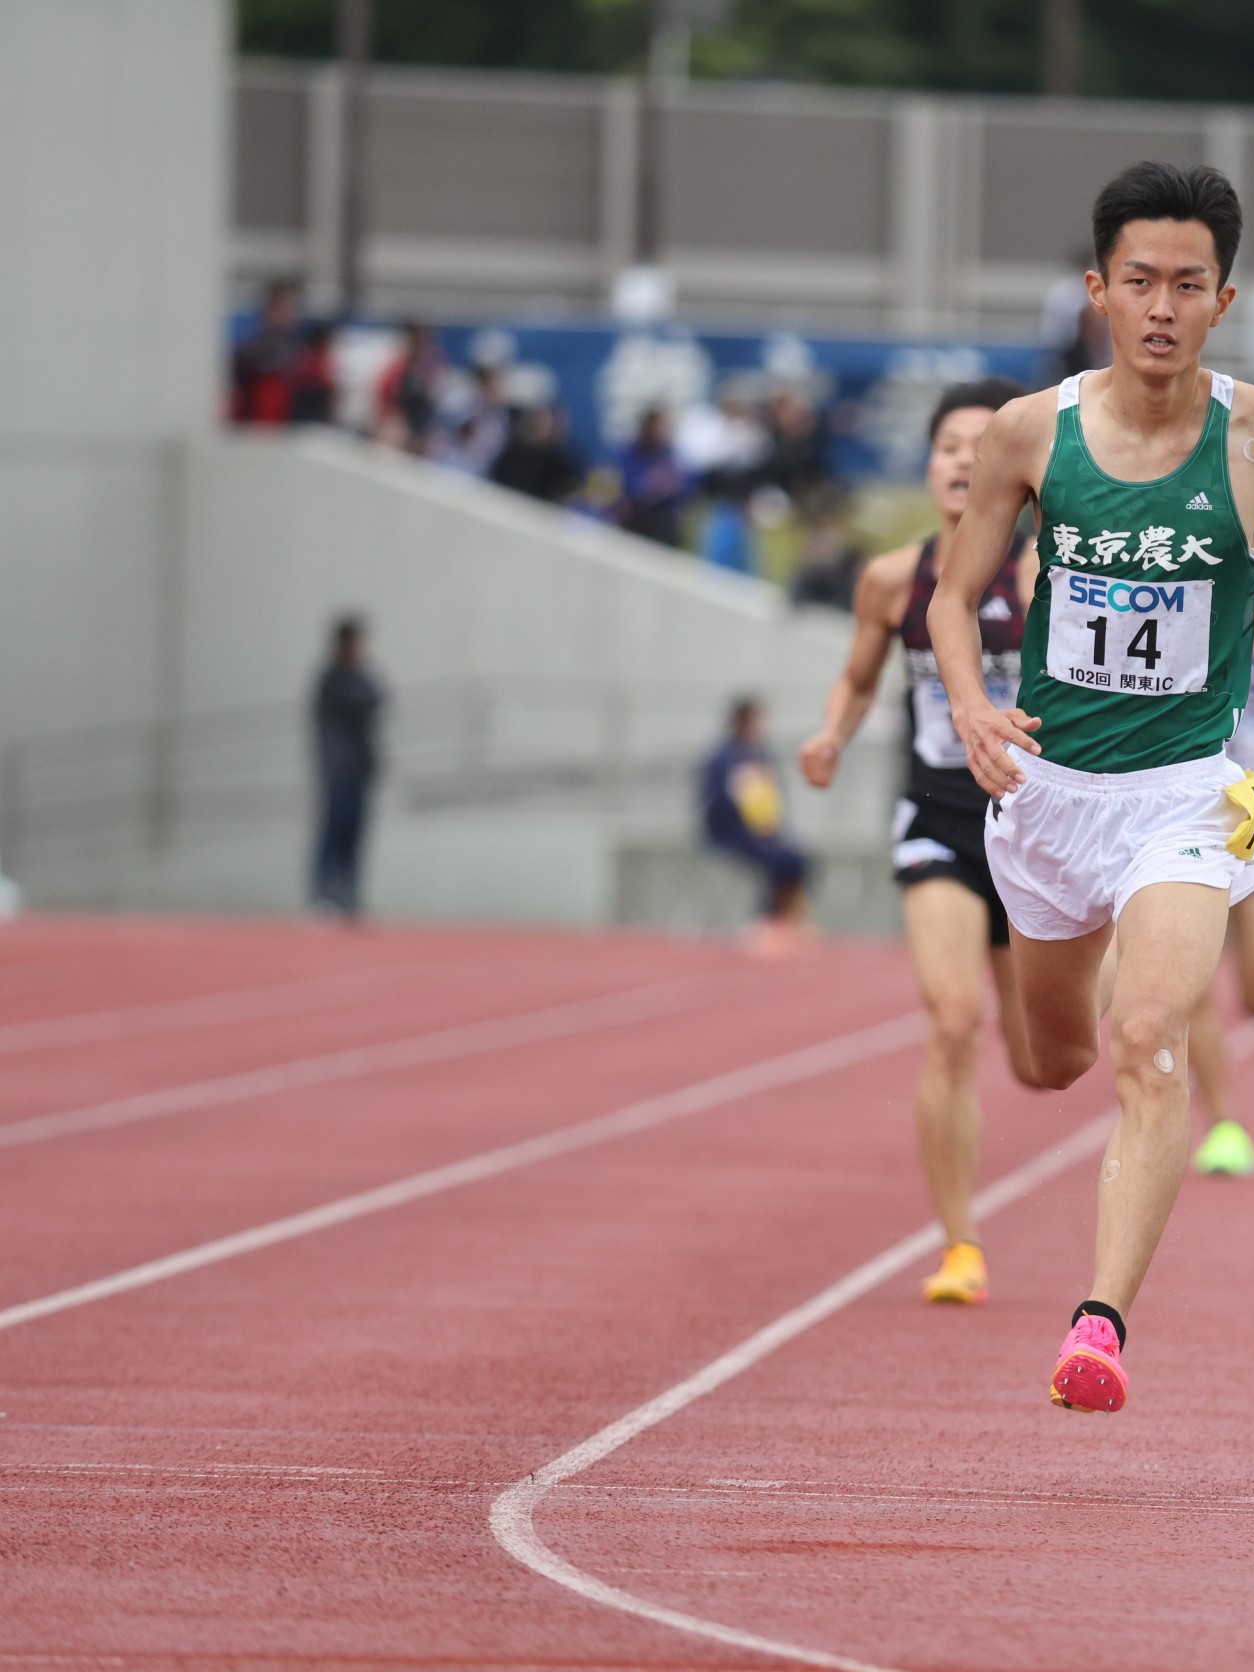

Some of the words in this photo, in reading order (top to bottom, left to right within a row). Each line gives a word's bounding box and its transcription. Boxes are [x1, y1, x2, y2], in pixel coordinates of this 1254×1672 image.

[1185, 502, 1213, 511] adidas
[1053, 523, 1223, 572] 東京農大
[1069, 575, 1185, 613] SECOM
[1086, 615, 1161, 670] 14
[1068, 667, 1111, 687] 102回
[1120, 674, 1174, 692] 関東IC
